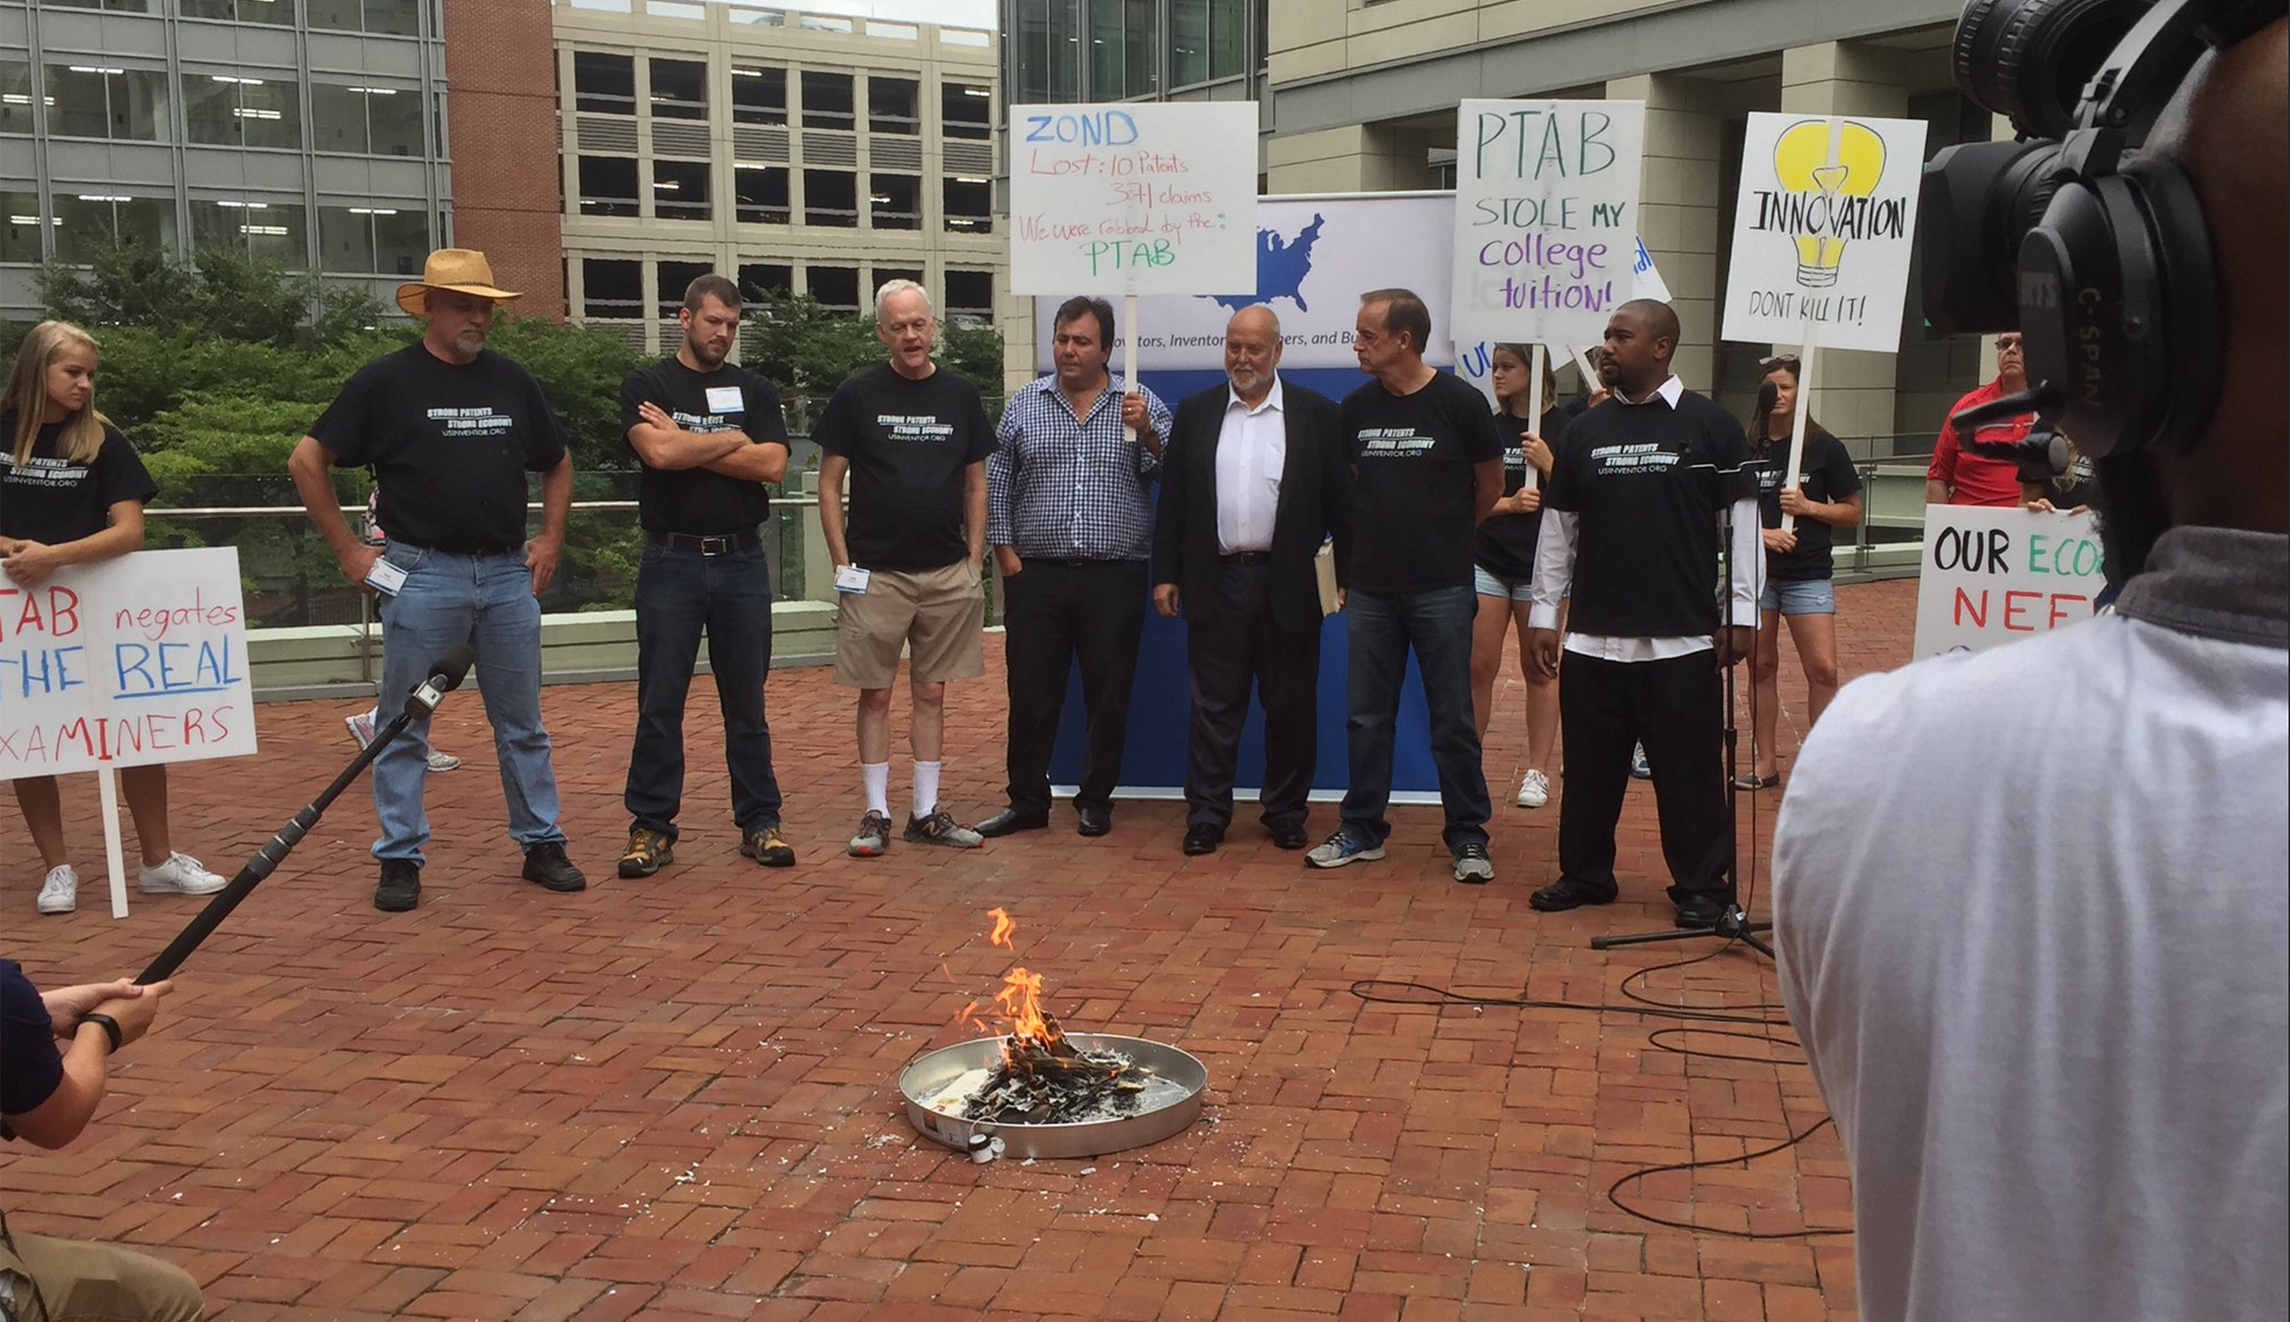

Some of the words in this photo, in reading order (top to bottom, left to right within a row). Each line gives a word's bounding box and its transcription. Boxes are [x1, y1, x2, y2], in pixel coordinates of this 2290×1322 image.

[1026, 110, 1139, 146] ZOND
[1031, 148, 1104, 175] Lost:
[1110, 154, 1134, 177] 10
[1139, 150, 1190, 175] Patents
[1476, 111, 1616, 181] PTAB
[1106, 182, 1152, 209] 371
[1159, 184, 1213, 203] claims
[1019, 213, 1050, 242] We
[1053, 224, 1092, 238] were
[1099, 214, 1154, 236] robbed
[1161, 213, 1182, 245] by
[1472, 196, 1579, 231] STOLE
[1592, 201, 1626, 228] MY
[1749, 190, 1907, 241] INNOVATION
[1079, 238, 1176, 277] PTAB
[1479, 232, 1608, 279] college
[1799, 295, 1829, 322] KILL
[1837, 295, 1867, 327] IT!
[1169, 333, 1226, 348] Inventor
[1311, 331, 1338, 345] and
[2077, 287, 2102, 407] C-SPAN
[1591, 445, 1622, 457] STRONG
[1622, 443, 1659, 454] PATENTS
[1605, 456, 1638, 466] STRONG
[47, 469, 89, 479] ECONOMY
[1934, 526, 2010, 575] OUR
[116, 586, 238, 642] negates
[114, 633, 243, 692] REAL
